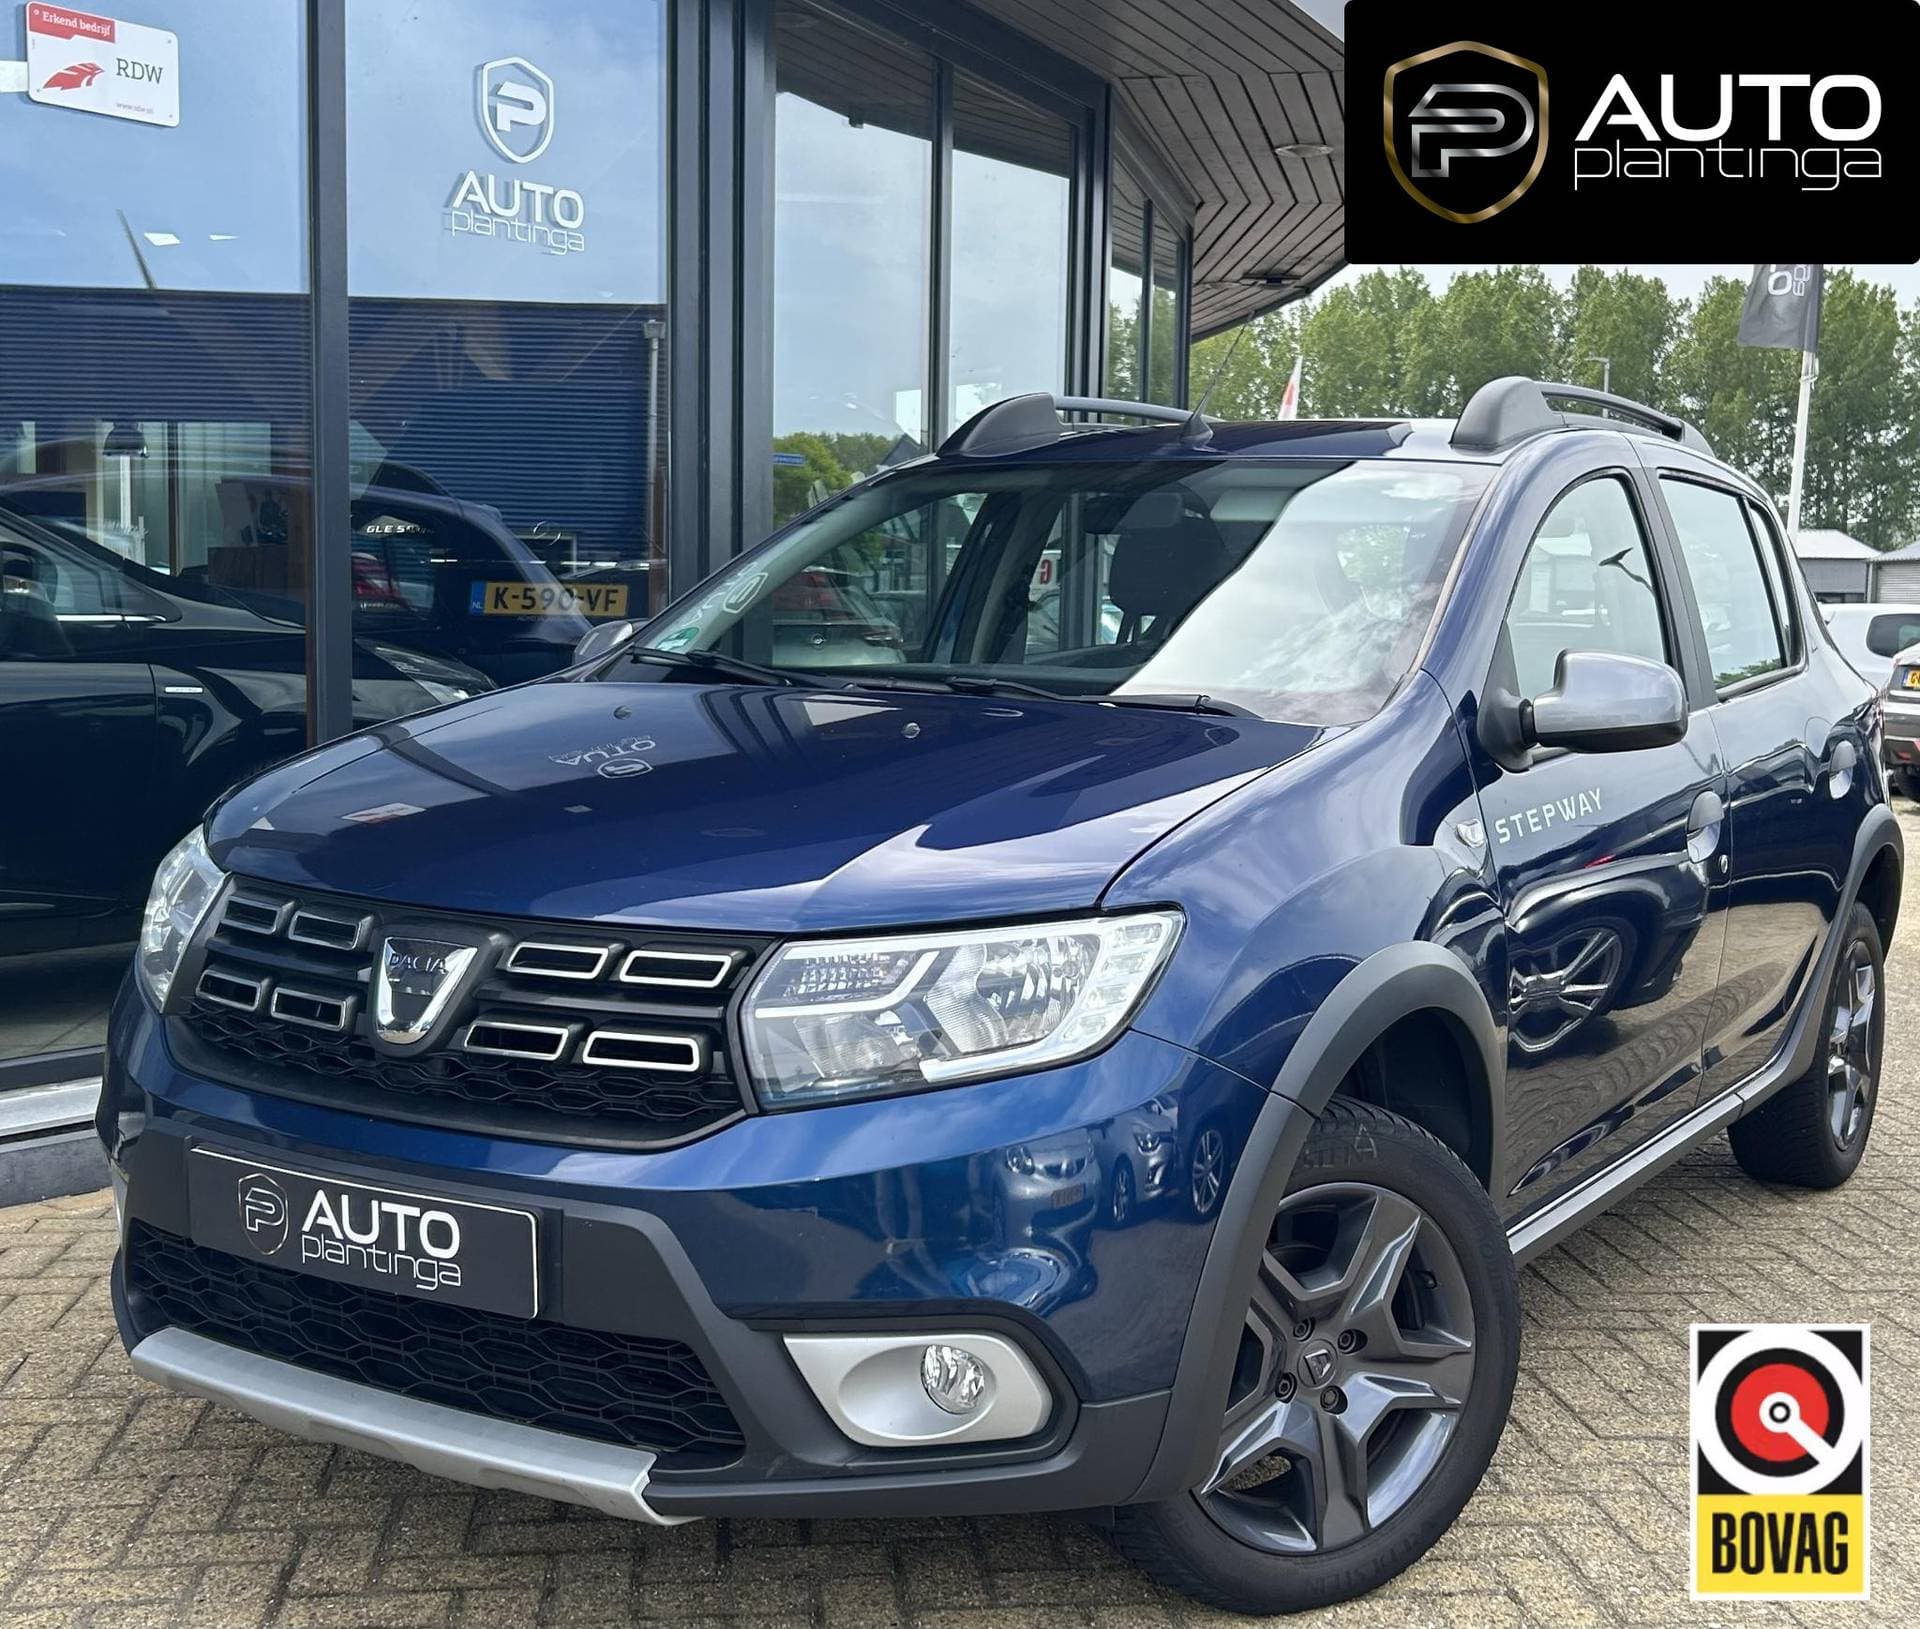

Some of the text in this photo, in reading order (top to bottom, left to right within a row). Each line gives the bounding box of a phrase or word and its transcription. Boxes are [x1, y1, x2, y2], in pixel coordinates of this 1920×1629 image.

[42, 11, 111, 37] Erkend bedrijf
[116, 57, 163, 85] RDW
[452, 170, 585, 229] AUTO
[451, 208, 585, 256] plantinga
[366, 525, 394, 533] GLE
[1495, 787, 1602, 844] STEPWAY
[389, 953, 449, 975] DACIA
[301, 1189, 461, 1259] AUTO
[301, 1233, 462, 1291] plantinga
